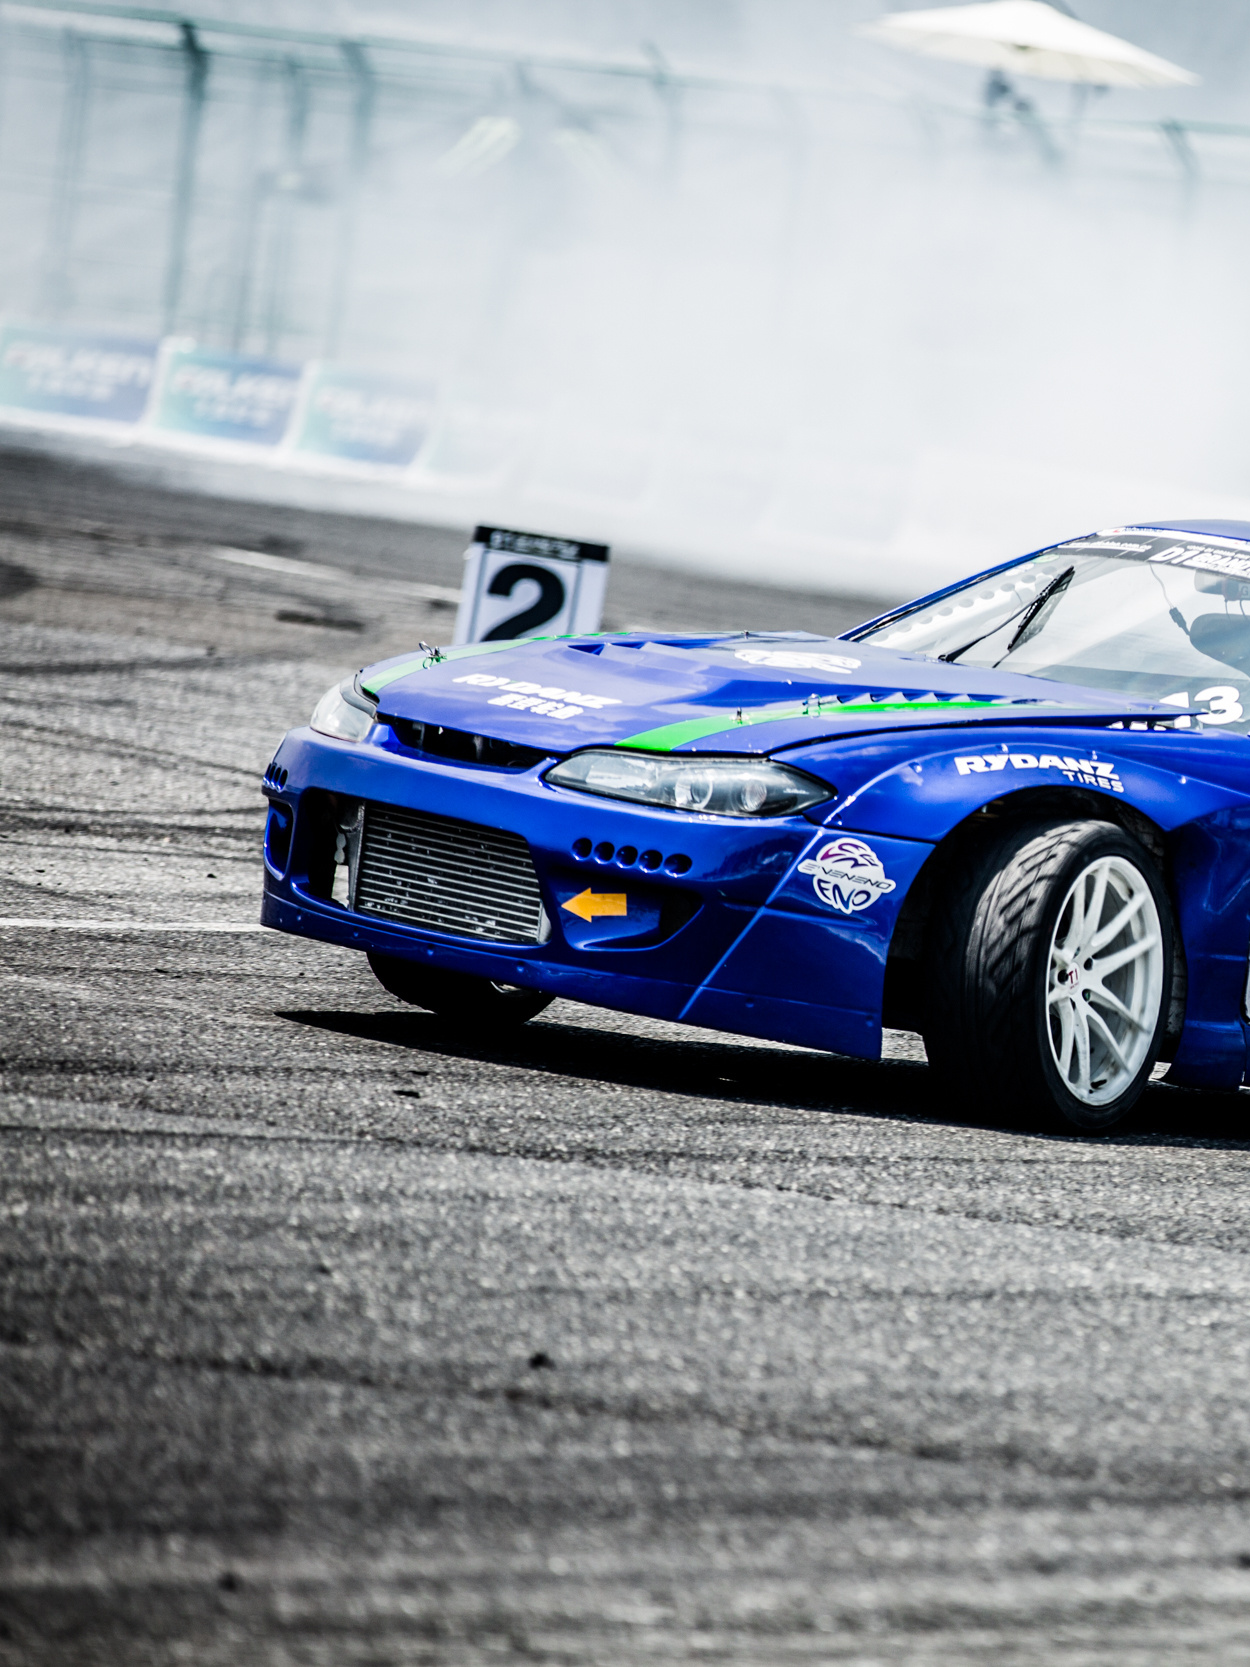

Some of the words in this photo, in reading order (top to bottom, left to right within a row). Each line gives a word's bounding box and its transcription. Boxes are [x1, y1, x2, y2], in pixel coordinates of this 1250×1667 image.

[481, 563, 565, 641] 2
[452, 673, 623, 709] RYDANZ
[954, 753, 1120, 781] RYDANZ
[1062, 770, 1125, 793] TIRES
